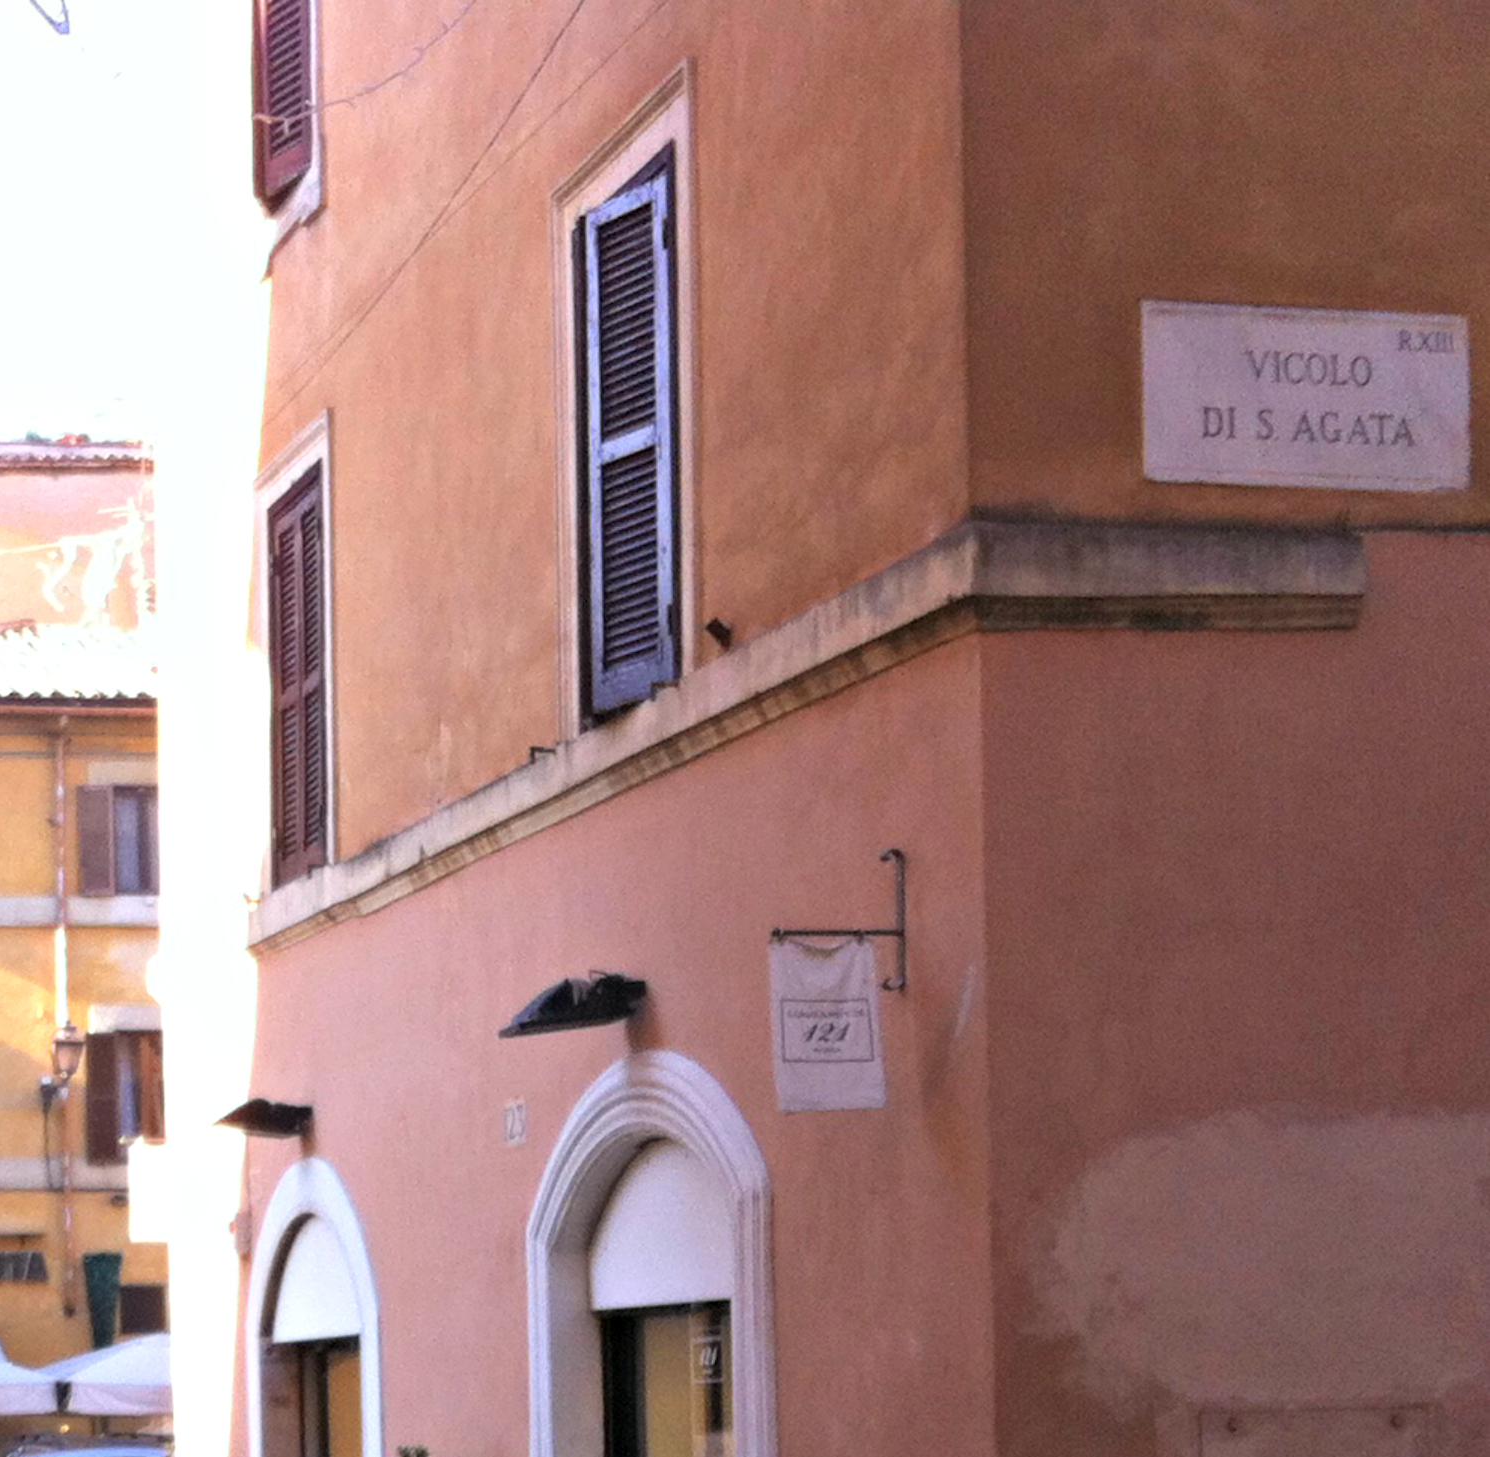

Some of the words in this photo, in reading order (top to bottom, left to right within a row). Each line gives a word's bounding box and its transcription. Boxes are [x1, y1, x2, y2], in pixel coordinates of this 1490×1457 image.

[1244, 350, 1373, 388] VICOLO
[1201, 406, 1237, 440] DI
[1291, 411, 1416, 447] AGATA
